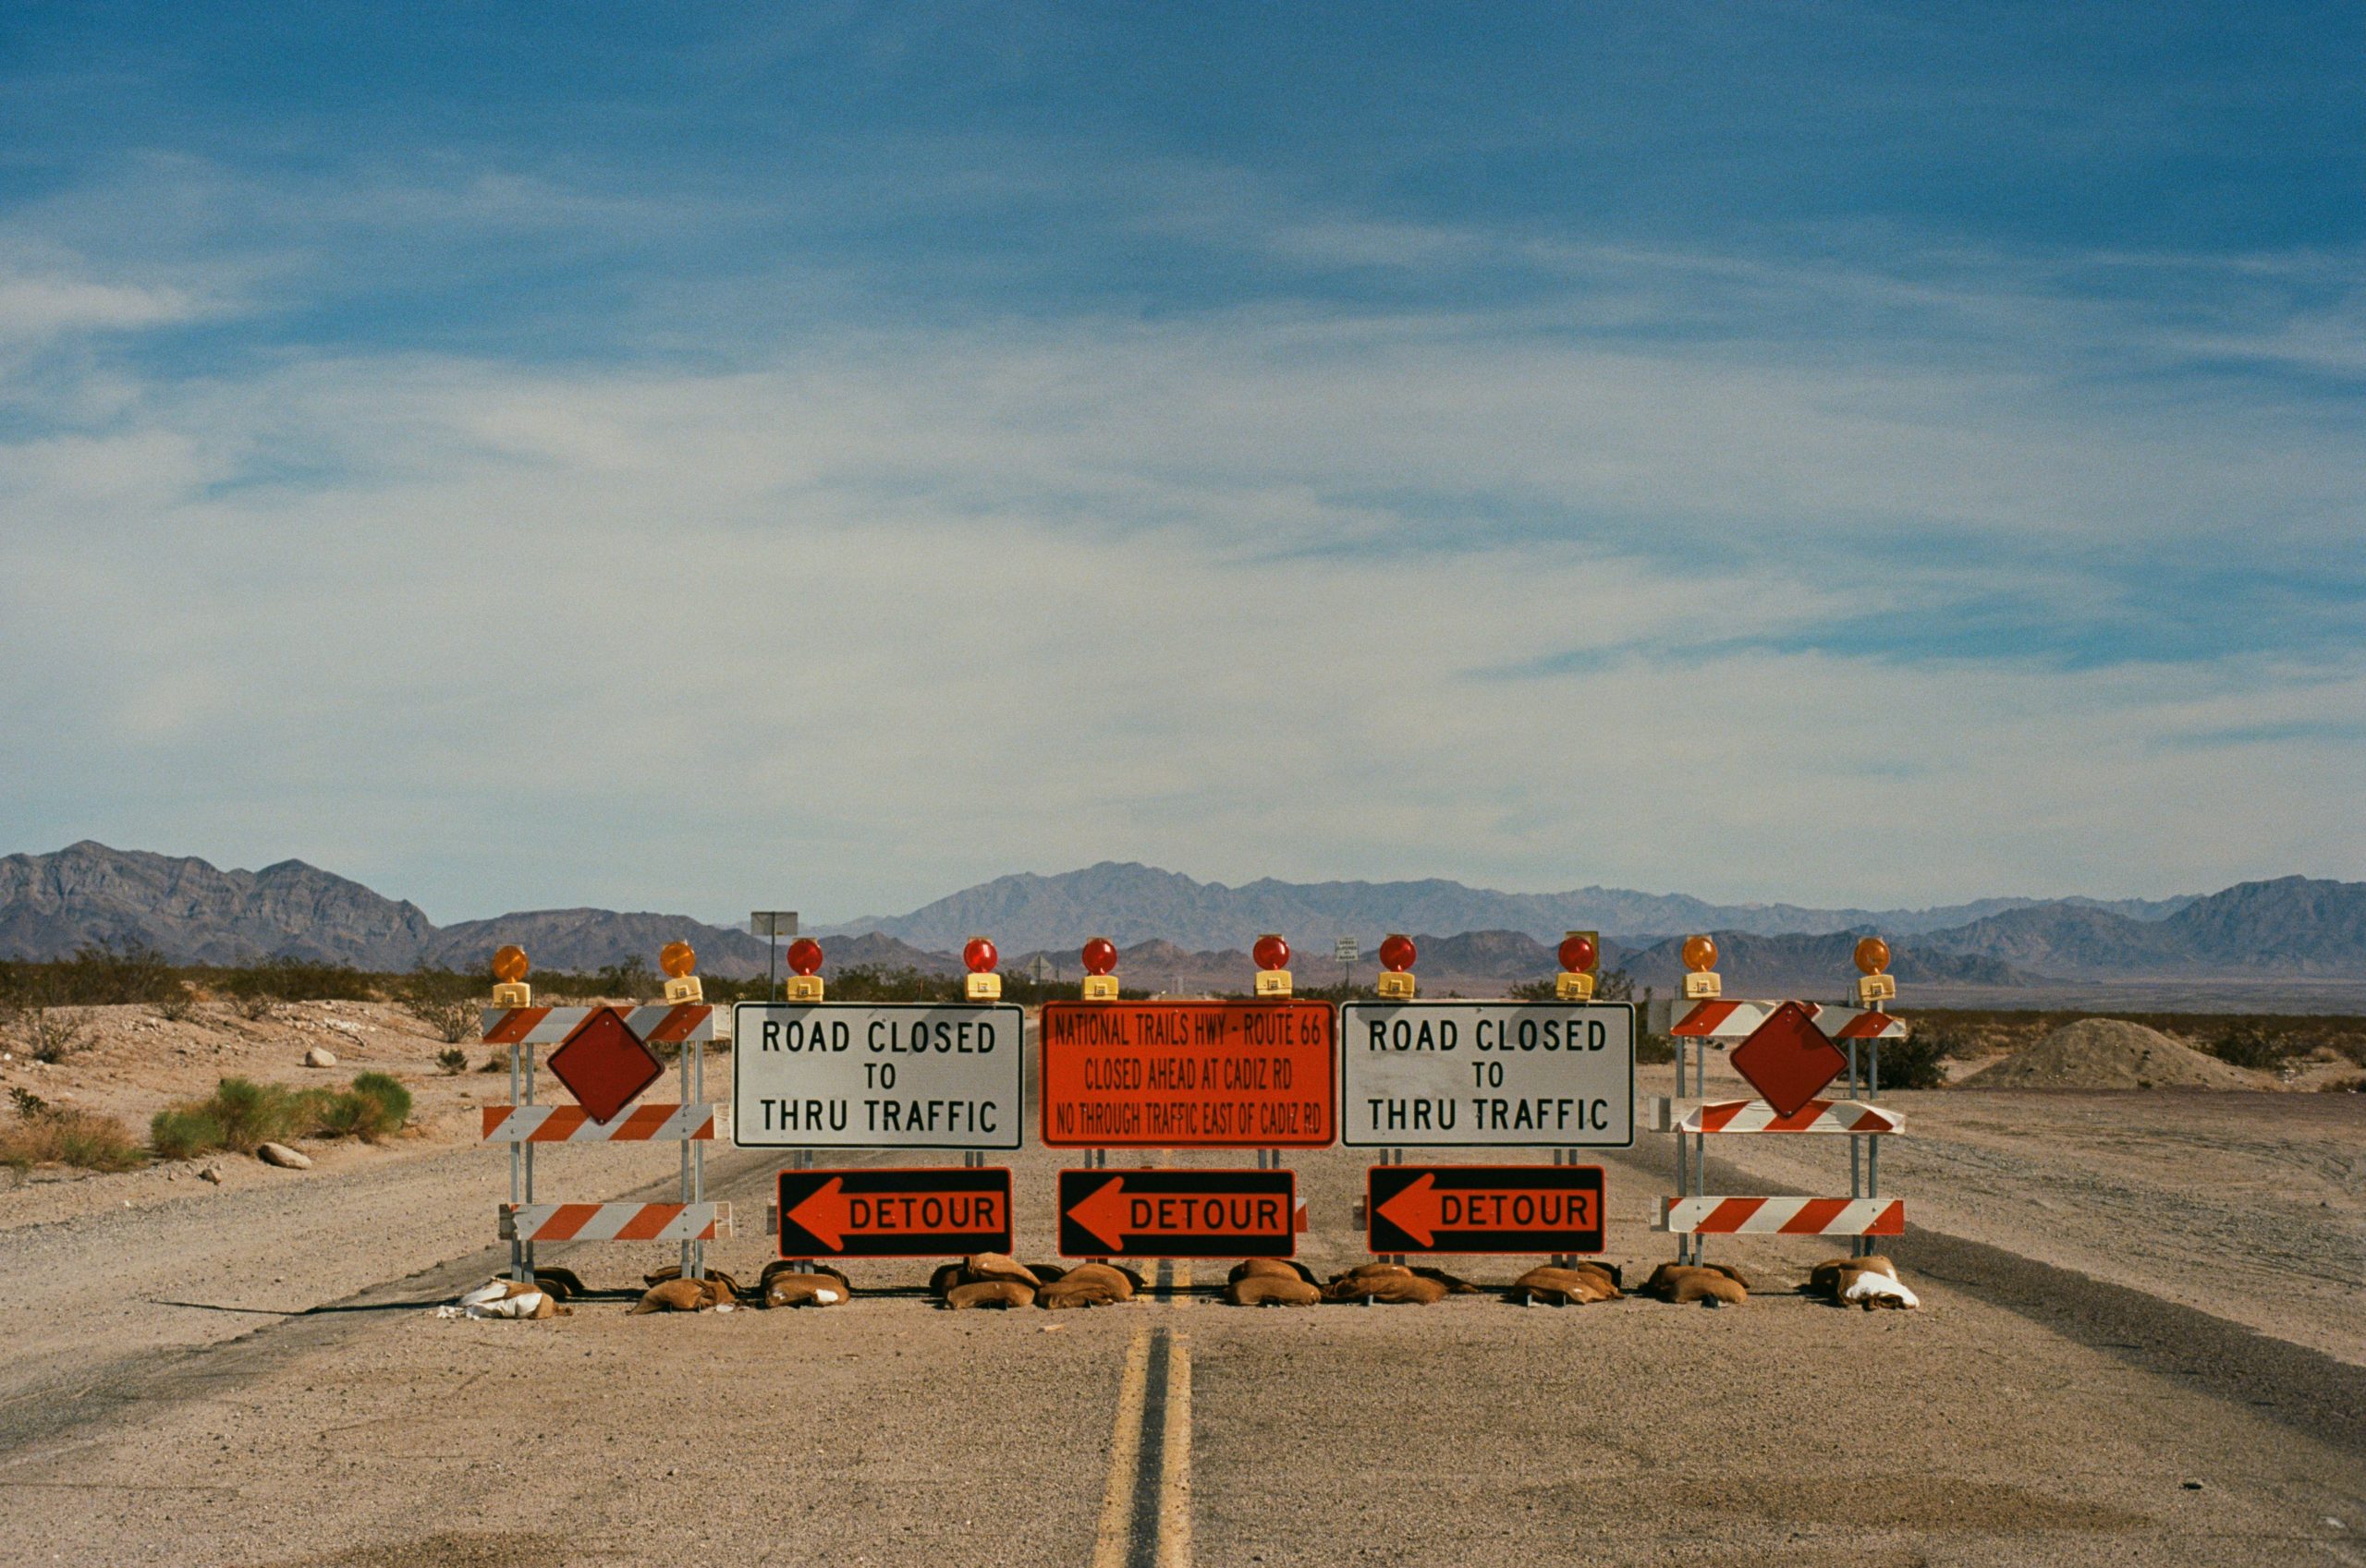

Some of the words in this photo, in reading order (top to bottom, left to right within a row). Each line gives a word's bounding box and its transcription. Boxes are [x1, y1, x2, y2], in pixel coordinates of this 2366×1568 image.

[763, 1020, 848, 1051] ROAD
[869, 1021, 994, 1052] CLOSED
[1055, 1014, 1129, 1046] NATIONAL
[1136, 1013, 1189, 1045] TRAILS
[1196, 1014, 1226, 1045] HWY
[1245, 1013, 1294, 1045] ROUTE
[1301, 1015, 1321, 1045] 66
[1370, 1020, 1457, 1051] ROAD
[1476, 1020, 1605, 1051] CLOSED
[864, 1064, 896, 1089] TO
[1085, 1058, 1140, 1090] CLOSED
[1149, 1058, 1195, 1089] AHEAD
[1201, 1058, 1218, 1088] AT
[1225, 1058, 1267, 1089] CADIZ
[1274, 1058, 1291, 1089] RD
[1472, 1062, 1503, 1088] TO
[761, 1100, 847, 1131] THRU
[864, 1100, 996, 1133] TRAFFIC
[1057, 1102, 1074, 1135] NO
[1079, 1102, 1140, 1135] THROUGH
[1145, 1102, 1197, 1135] TRAFFIC
[1203, 1102, 1234, 1135] EAST
[1239, 1102, 1254, 1135] OF
[1261, 1102, 1299, 1135] CADIZ
[1304, 1102, 1320, 1134] RD
[1368, 1099, 1455, 1130] THRU
[1472, 1099, 1607, 1130] TRAFFIC
[850, 1197, 994, 1229] DETOUR
[1131, 1199, 1277, 1229] DETOUR
[1442, 1195, 1587, 1225] DETOUR
